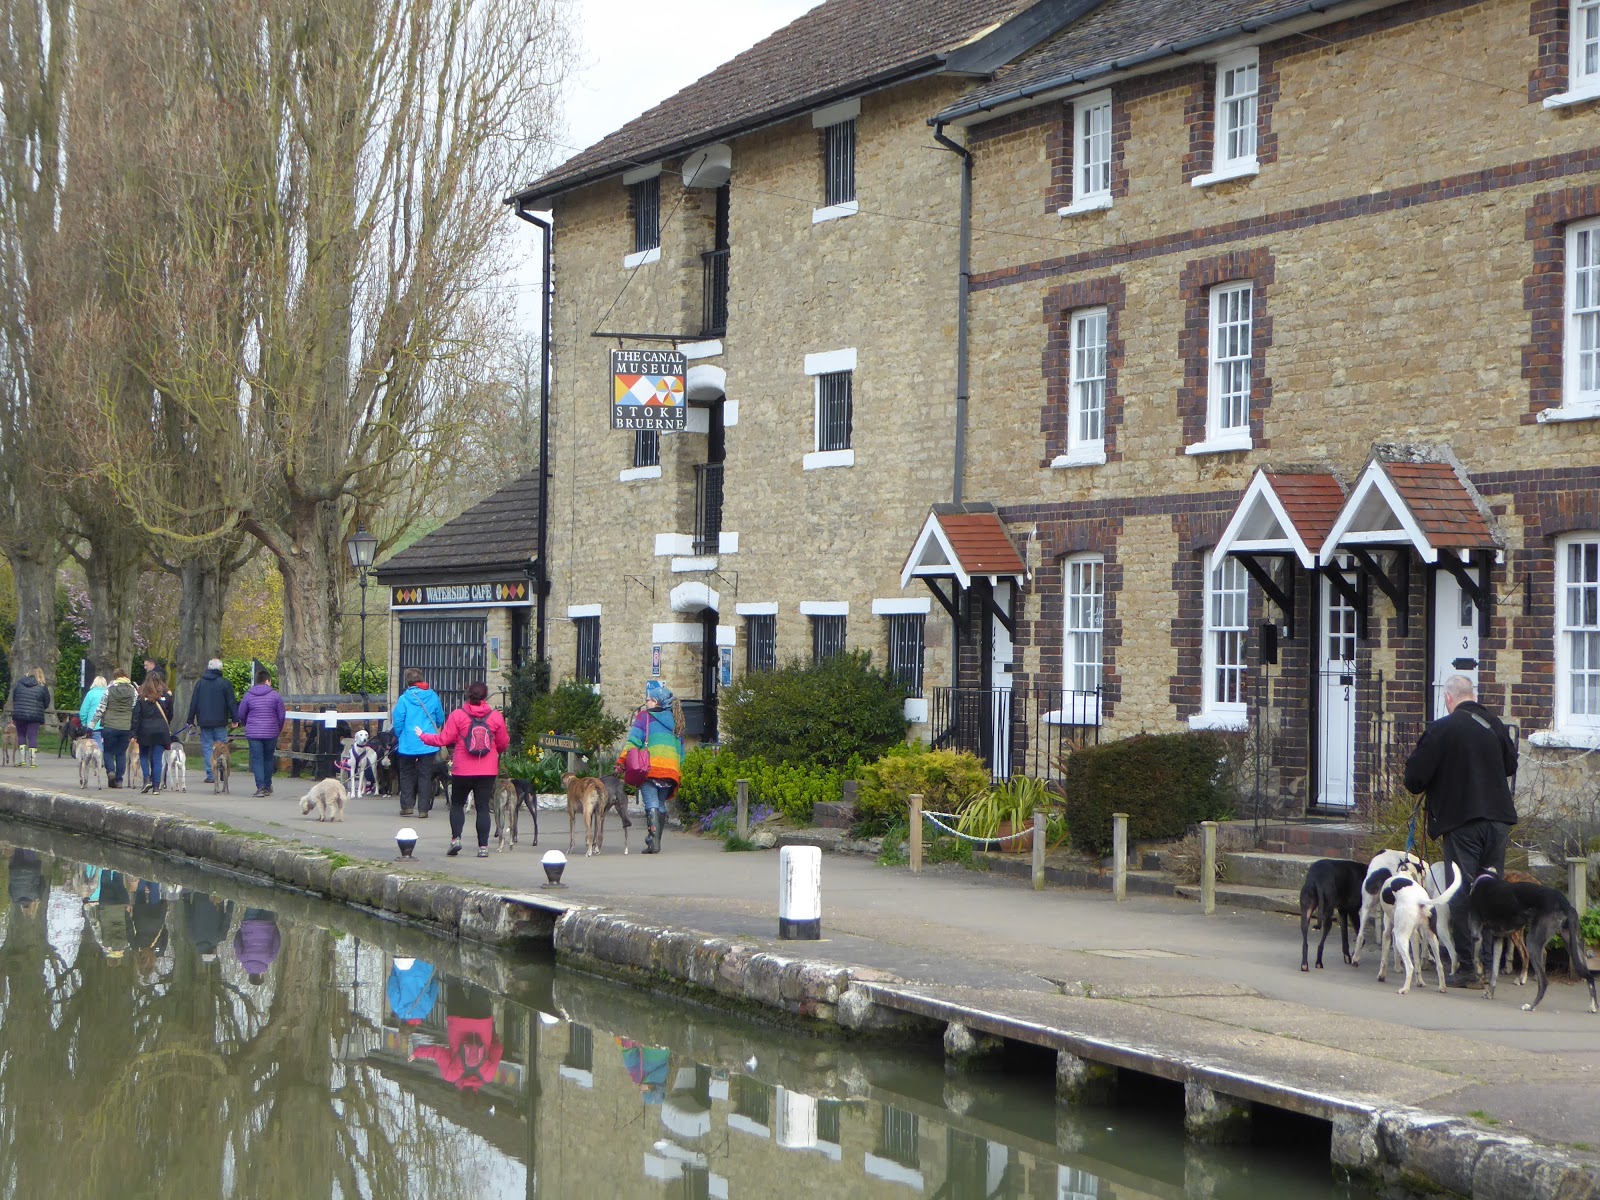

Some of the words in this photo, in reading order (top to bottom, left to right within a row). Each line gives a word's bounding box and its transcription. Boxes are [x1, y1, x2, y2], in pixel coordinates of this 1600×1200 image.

[615, 351, 641, 362] THE
[643, 352, 684, 363] CANAL
[616, 363, 683, 375] MUSEUM
[616, 406, 684, 418] STOKE
[616, 419, 684, 430] BRUERNE
[425, 585, 470, 603] WATERSIDE
[1462, 636, 1468, 650] 3
[1344, 686, 1350, 701] 2
[545, 737, 558, 747] CANAL
